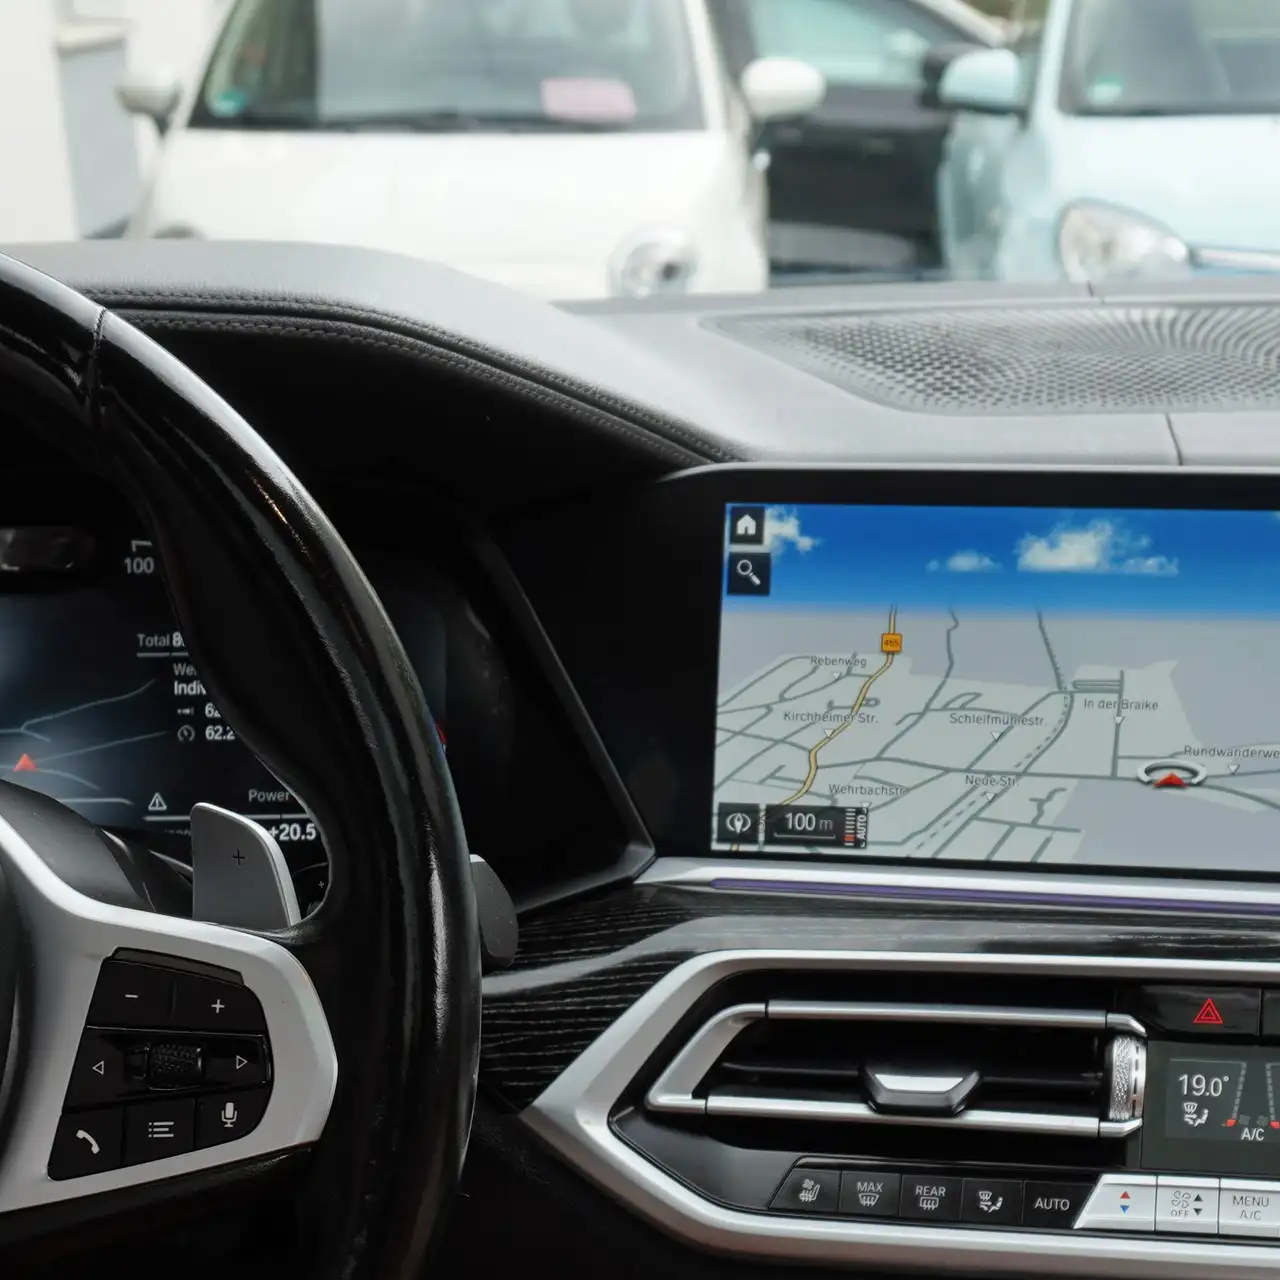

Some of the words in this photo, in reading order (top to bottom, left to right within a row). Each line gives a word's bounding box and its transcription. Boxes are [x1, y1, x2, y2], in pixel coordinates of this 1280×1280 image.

[124, 557, 154, 574] 100
[137, 633, 170, 647] Total
[172, 631, 186, 648] 8
[810, 656, 867, 668] Rebenweg
[1083, 699, 1095, 709] In
[1097, 699, 1118, 710] der
[1121, 699, 1159, 711] Braike
[784, 711, 855, 723] Kirchheimer
[858, 713, 879, 724] Str.
[965, 775, 997, 786] Neue
[999, 776, 1020, 787] Str.
[248, 788, 290, 802] Power
[785, 812, 816, 831] 100
[819, 819, 833, 831] m
[856, 814, 867, 839] AUTO
[1240, 1127, 1265, 1142] A/C
[856, 1181, 885, 1193] MAX
[915, 1185, 946, 1197] REAR
[1034, 1198, 1070, 1211] AUTO
[1232, 1195, 1270, 1207] MENU
[1171, 1210, 1190, 1218] OFF
[1239, 1209, 1262, 1221] A/C
